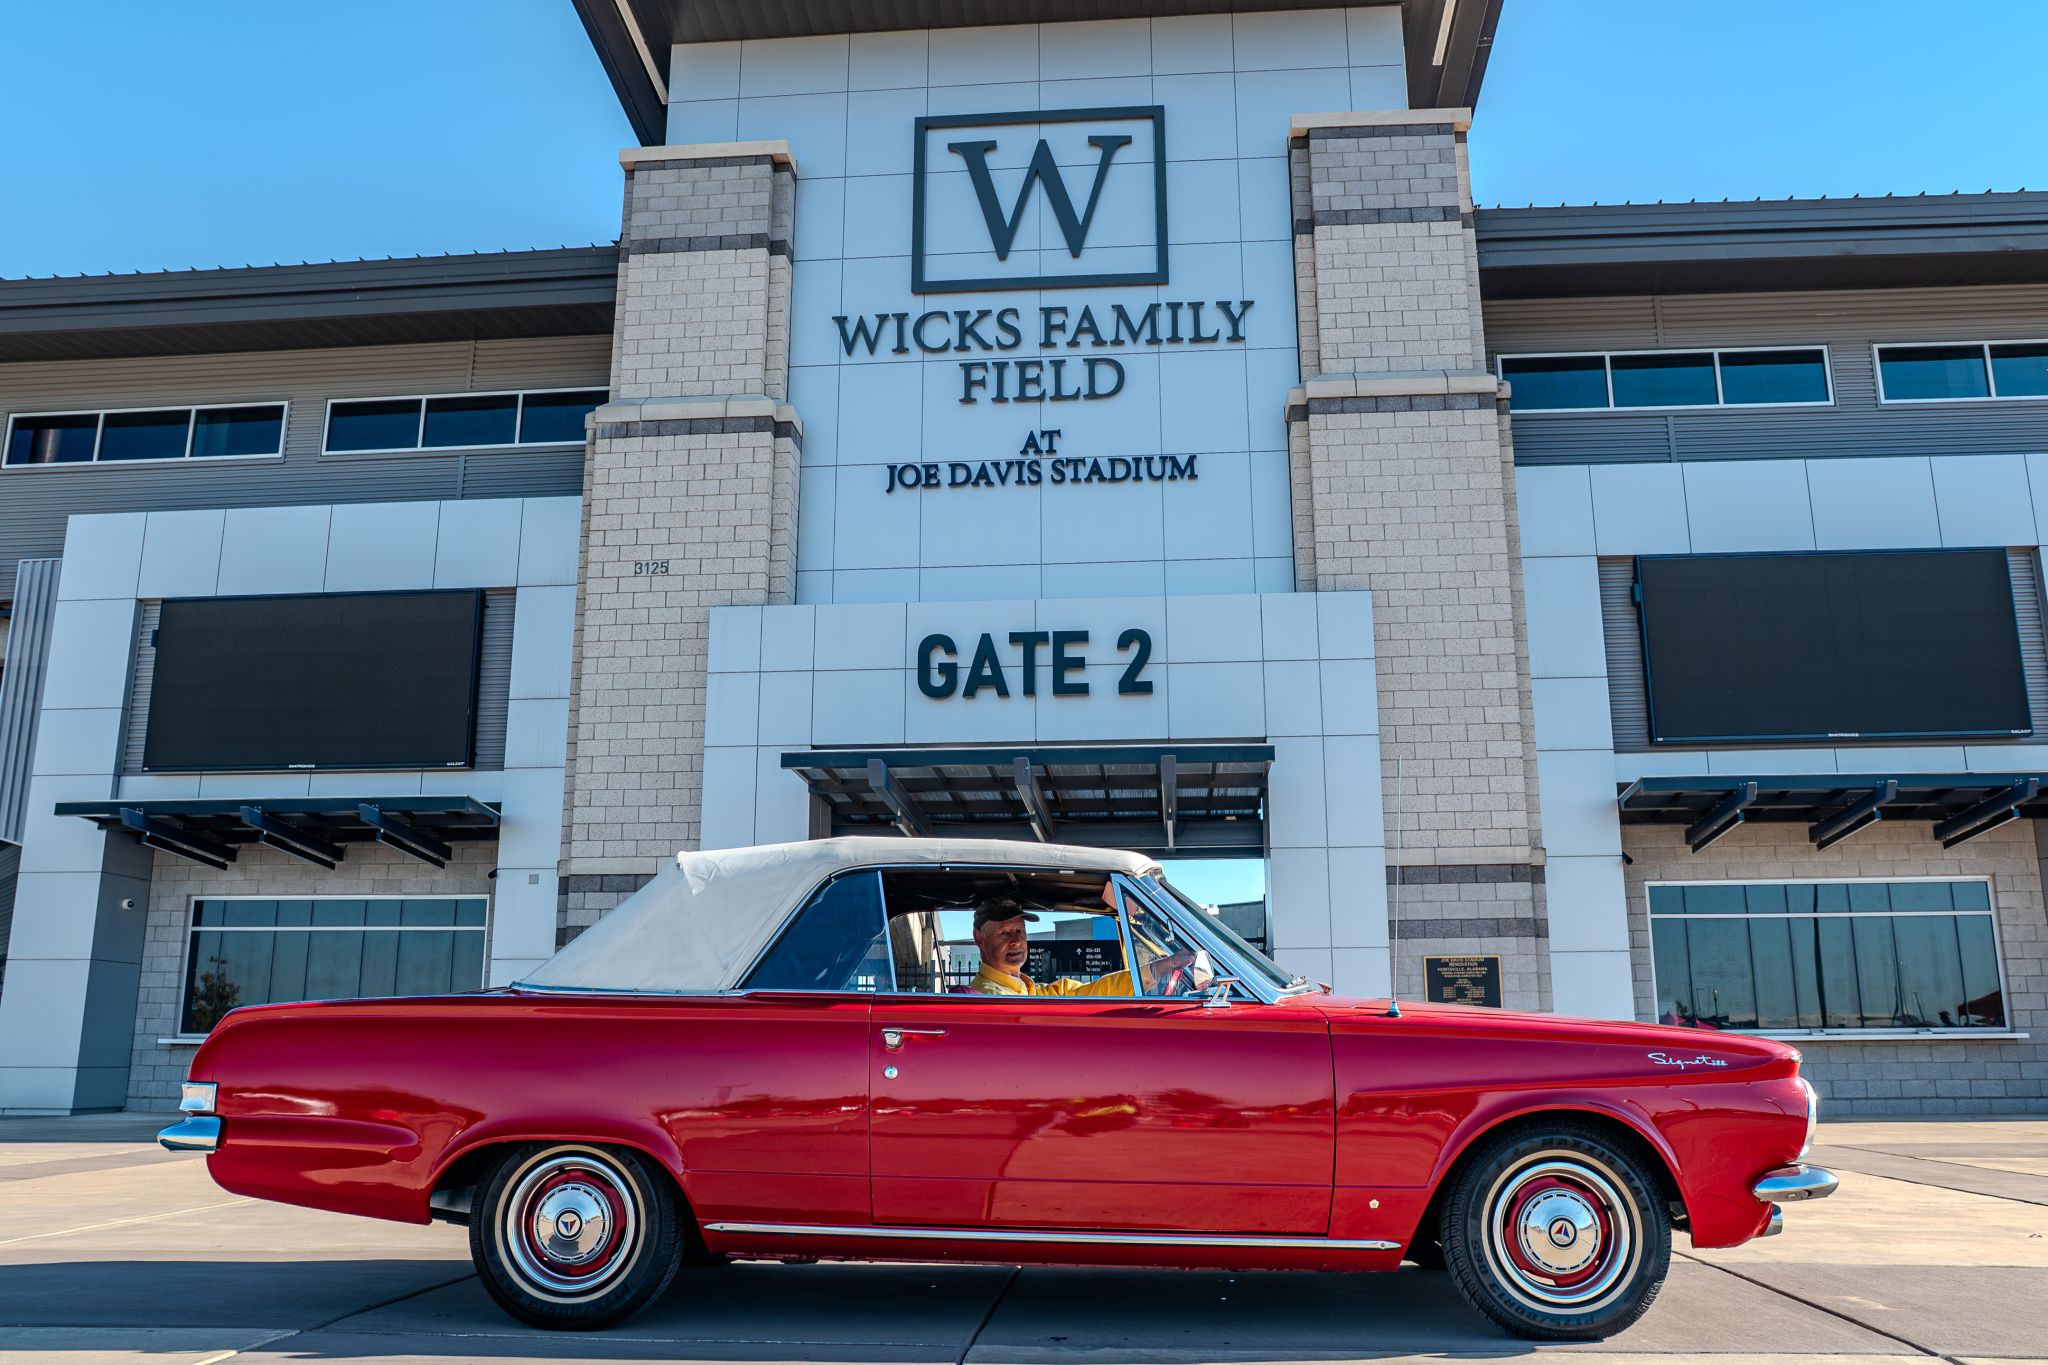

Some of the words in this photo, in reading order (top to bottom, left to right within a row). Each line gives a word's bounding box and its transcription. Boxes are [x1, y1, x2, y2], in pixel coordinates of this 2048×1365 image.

[947, 135, 1132, 261] W
[832, 307, 1022, 356] WICKS
[1039, 300, 1255, 348] FAMILY
[958, 357, 1126, 403] FIELD
[1019, 429, 1061, 455] AT
[885, 463, 940, 494] JOE
[947, 459, 1042, 487] DAVIS
[1050, 455, 1199, 484] STADIUM
[635, 561, 669, 575] 3125
[917, 630, 1090, 699] GATE
[1116, 628, 1154, 695] 2
[1647, 1052, 1712, 1070] Signet
